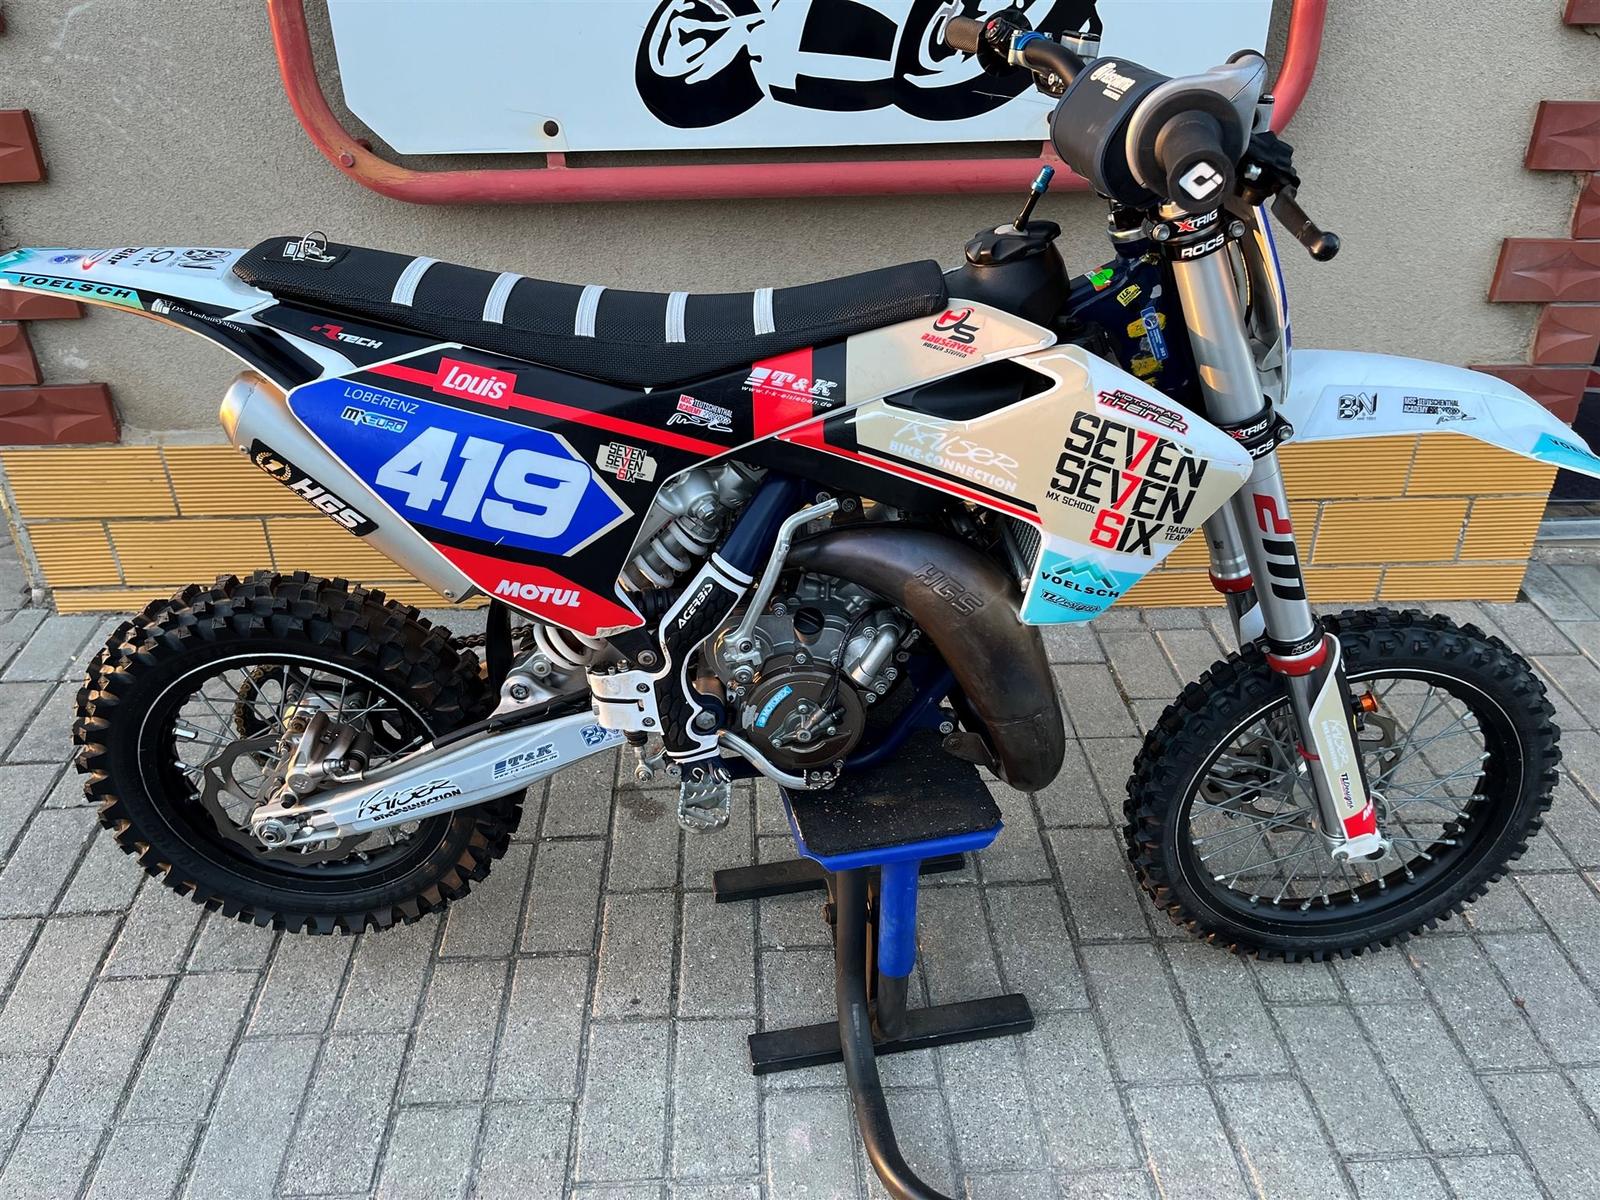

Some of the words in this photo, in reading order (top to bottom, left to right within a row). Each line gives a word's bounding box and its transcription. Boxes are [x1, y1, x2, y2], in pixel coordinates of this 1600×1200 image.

[1174, 208, 1218, 232] XTRIG
[1181, 233, 1225, 258] ROCS
[18, 275, 132, 299] VOELSCH
[442, 366, 507, 400] Louis
[343, 386, 420, 415] LOBERENZ
[1114, 391, 1182, 421] MOTORRAD
[1226, 419, 1268, 440] XTRIG
[606, 453, 643, 472] SEVEN
[609, 442, 647, 462] SEVEN
[1064, 411, 1208, 489] SEVEN
[374, 426, 592, 539] 419
[1050, 452, 1197, 524] SEVEN
[289, 477, 367, 528] HGS
[1045, 490, 1060, 502] MX
[1062, 497, 1097, 515] SCHOOL
[1167, 525, 1195, 535] RACIN
[494, 579, 581, 608] MOTUL
[913, 562, 985, 617] HGS
[1041, 571, 1120, 599] VOELSCH
[678, 583, 714, 630] ACERBIS
